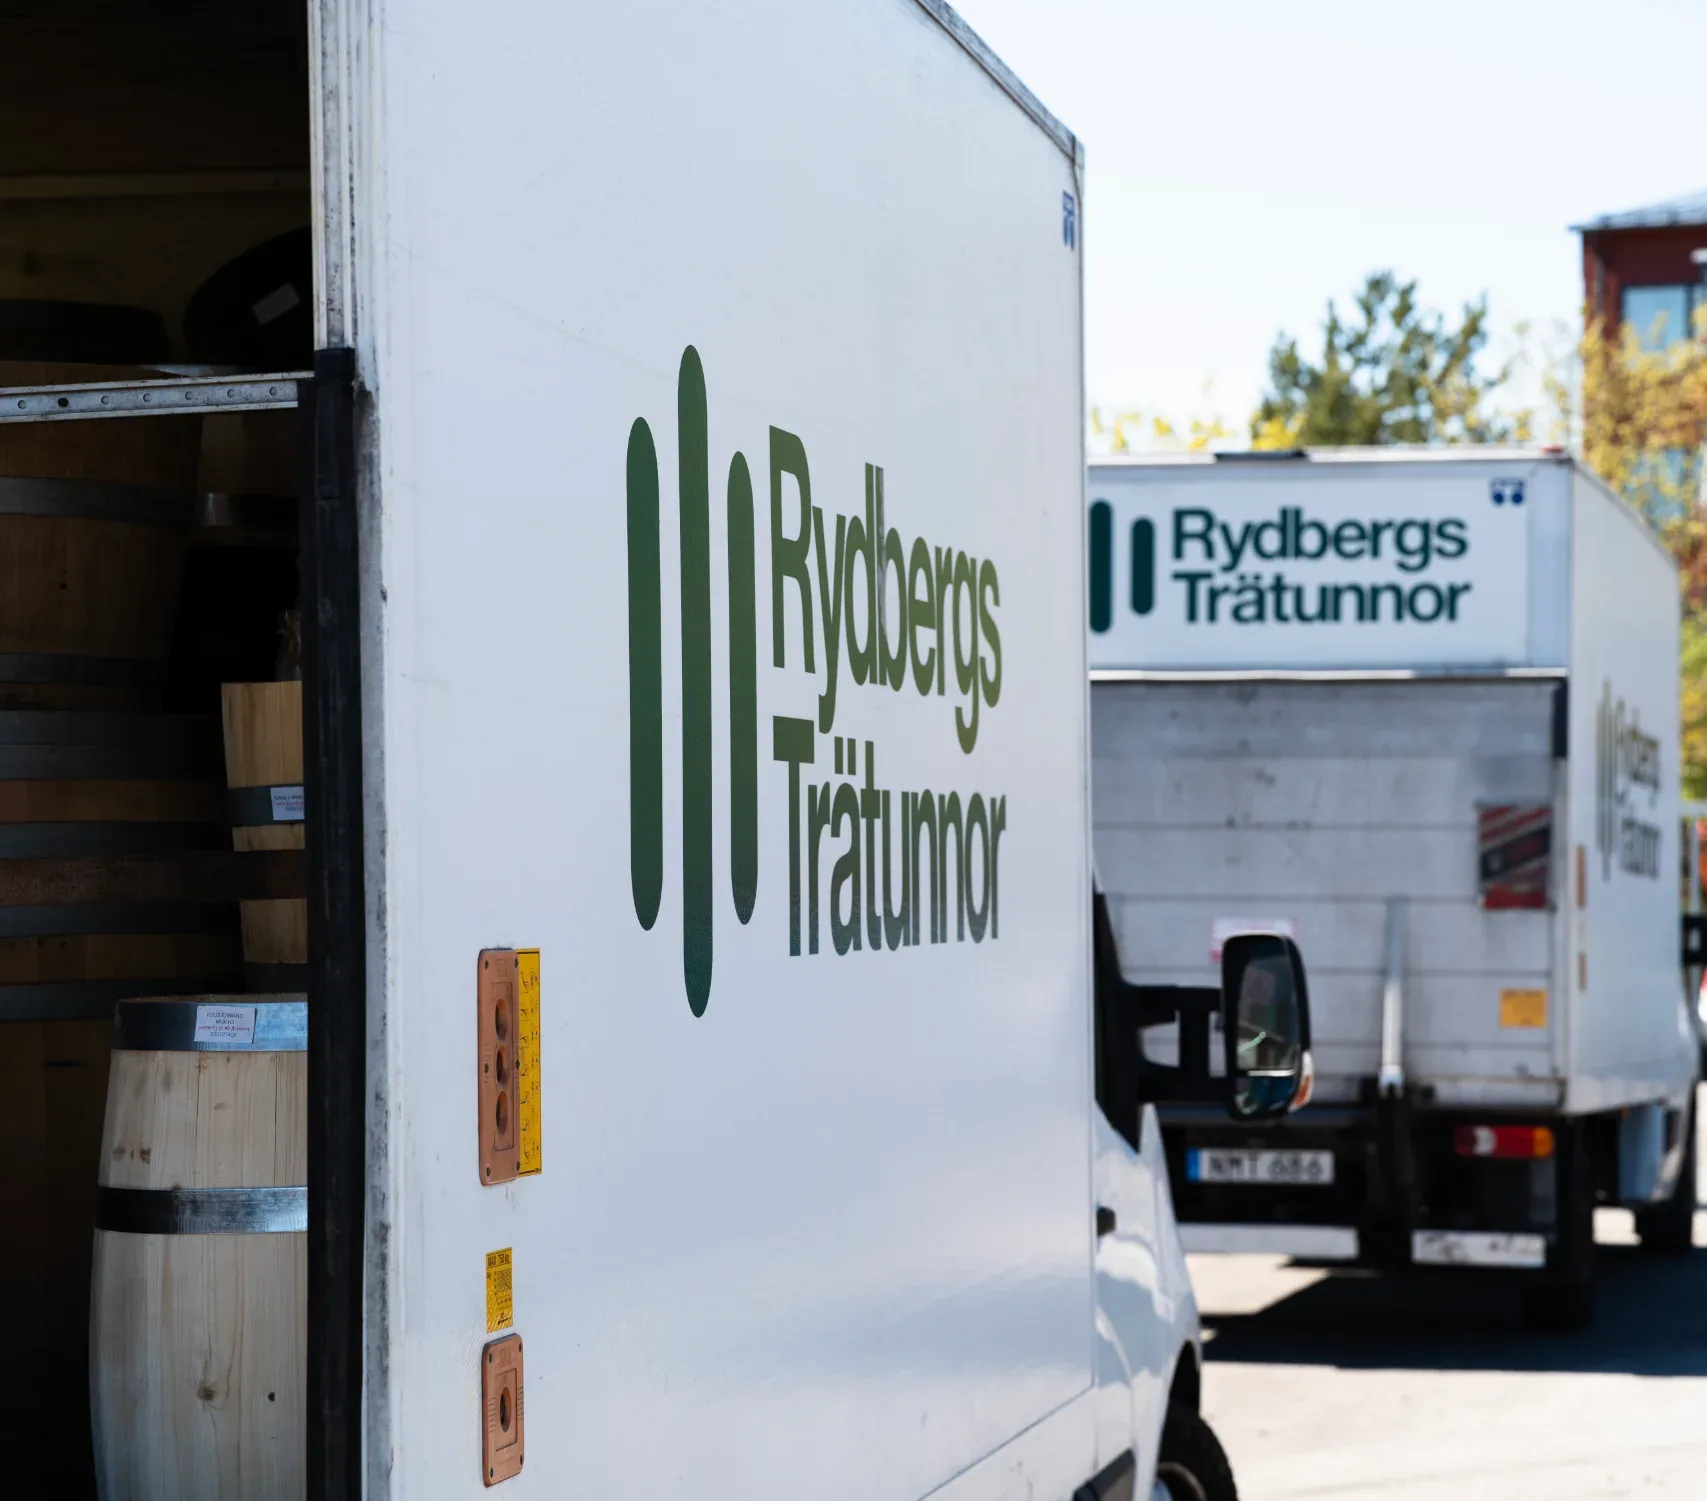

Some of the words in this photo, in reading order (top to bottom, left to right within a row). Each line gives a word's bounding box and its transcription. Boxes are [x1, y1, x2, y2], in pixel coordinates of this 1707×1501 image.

[769, 425, 1002, 754] Rydbergs
[1171, 571, 1472, 623] Trätunnor
[1172, 506, 1468, 572] Rydbergs
[773, 715, 1006, 956] Trätunnor
